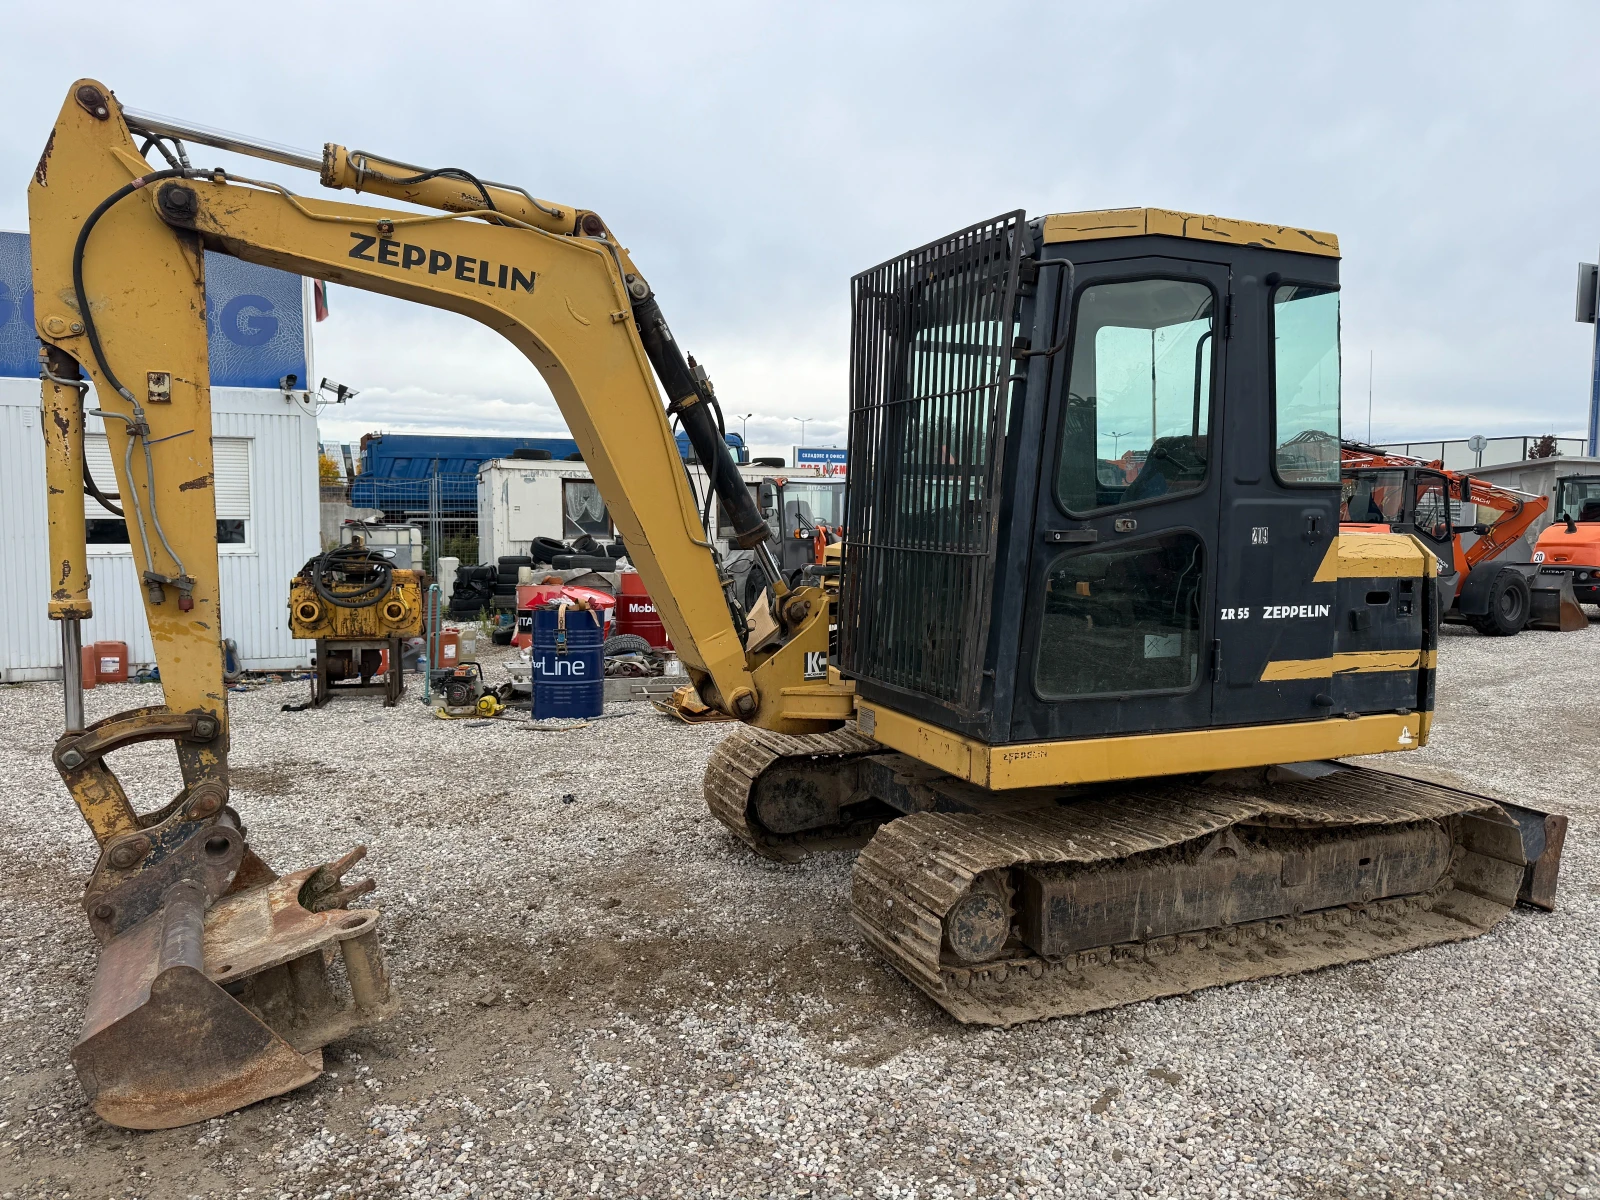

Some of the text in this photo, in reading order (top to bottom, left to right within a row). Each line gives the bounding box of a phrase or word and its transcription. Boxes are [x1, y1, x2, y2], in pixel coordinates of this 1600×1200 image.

[348, 231, 537, 294] ZEPPELIN
[822, 465, 847, 475] НЕМ
[1470, 496, 1491, 504] ITACHI
[1534, 553, 1543, 561] 20
[1221, 607, 1250, 620] ZR 55
[1262, 604, 1330, 619] ZEPPELIN
[519, 617, 533, 626] ITA
